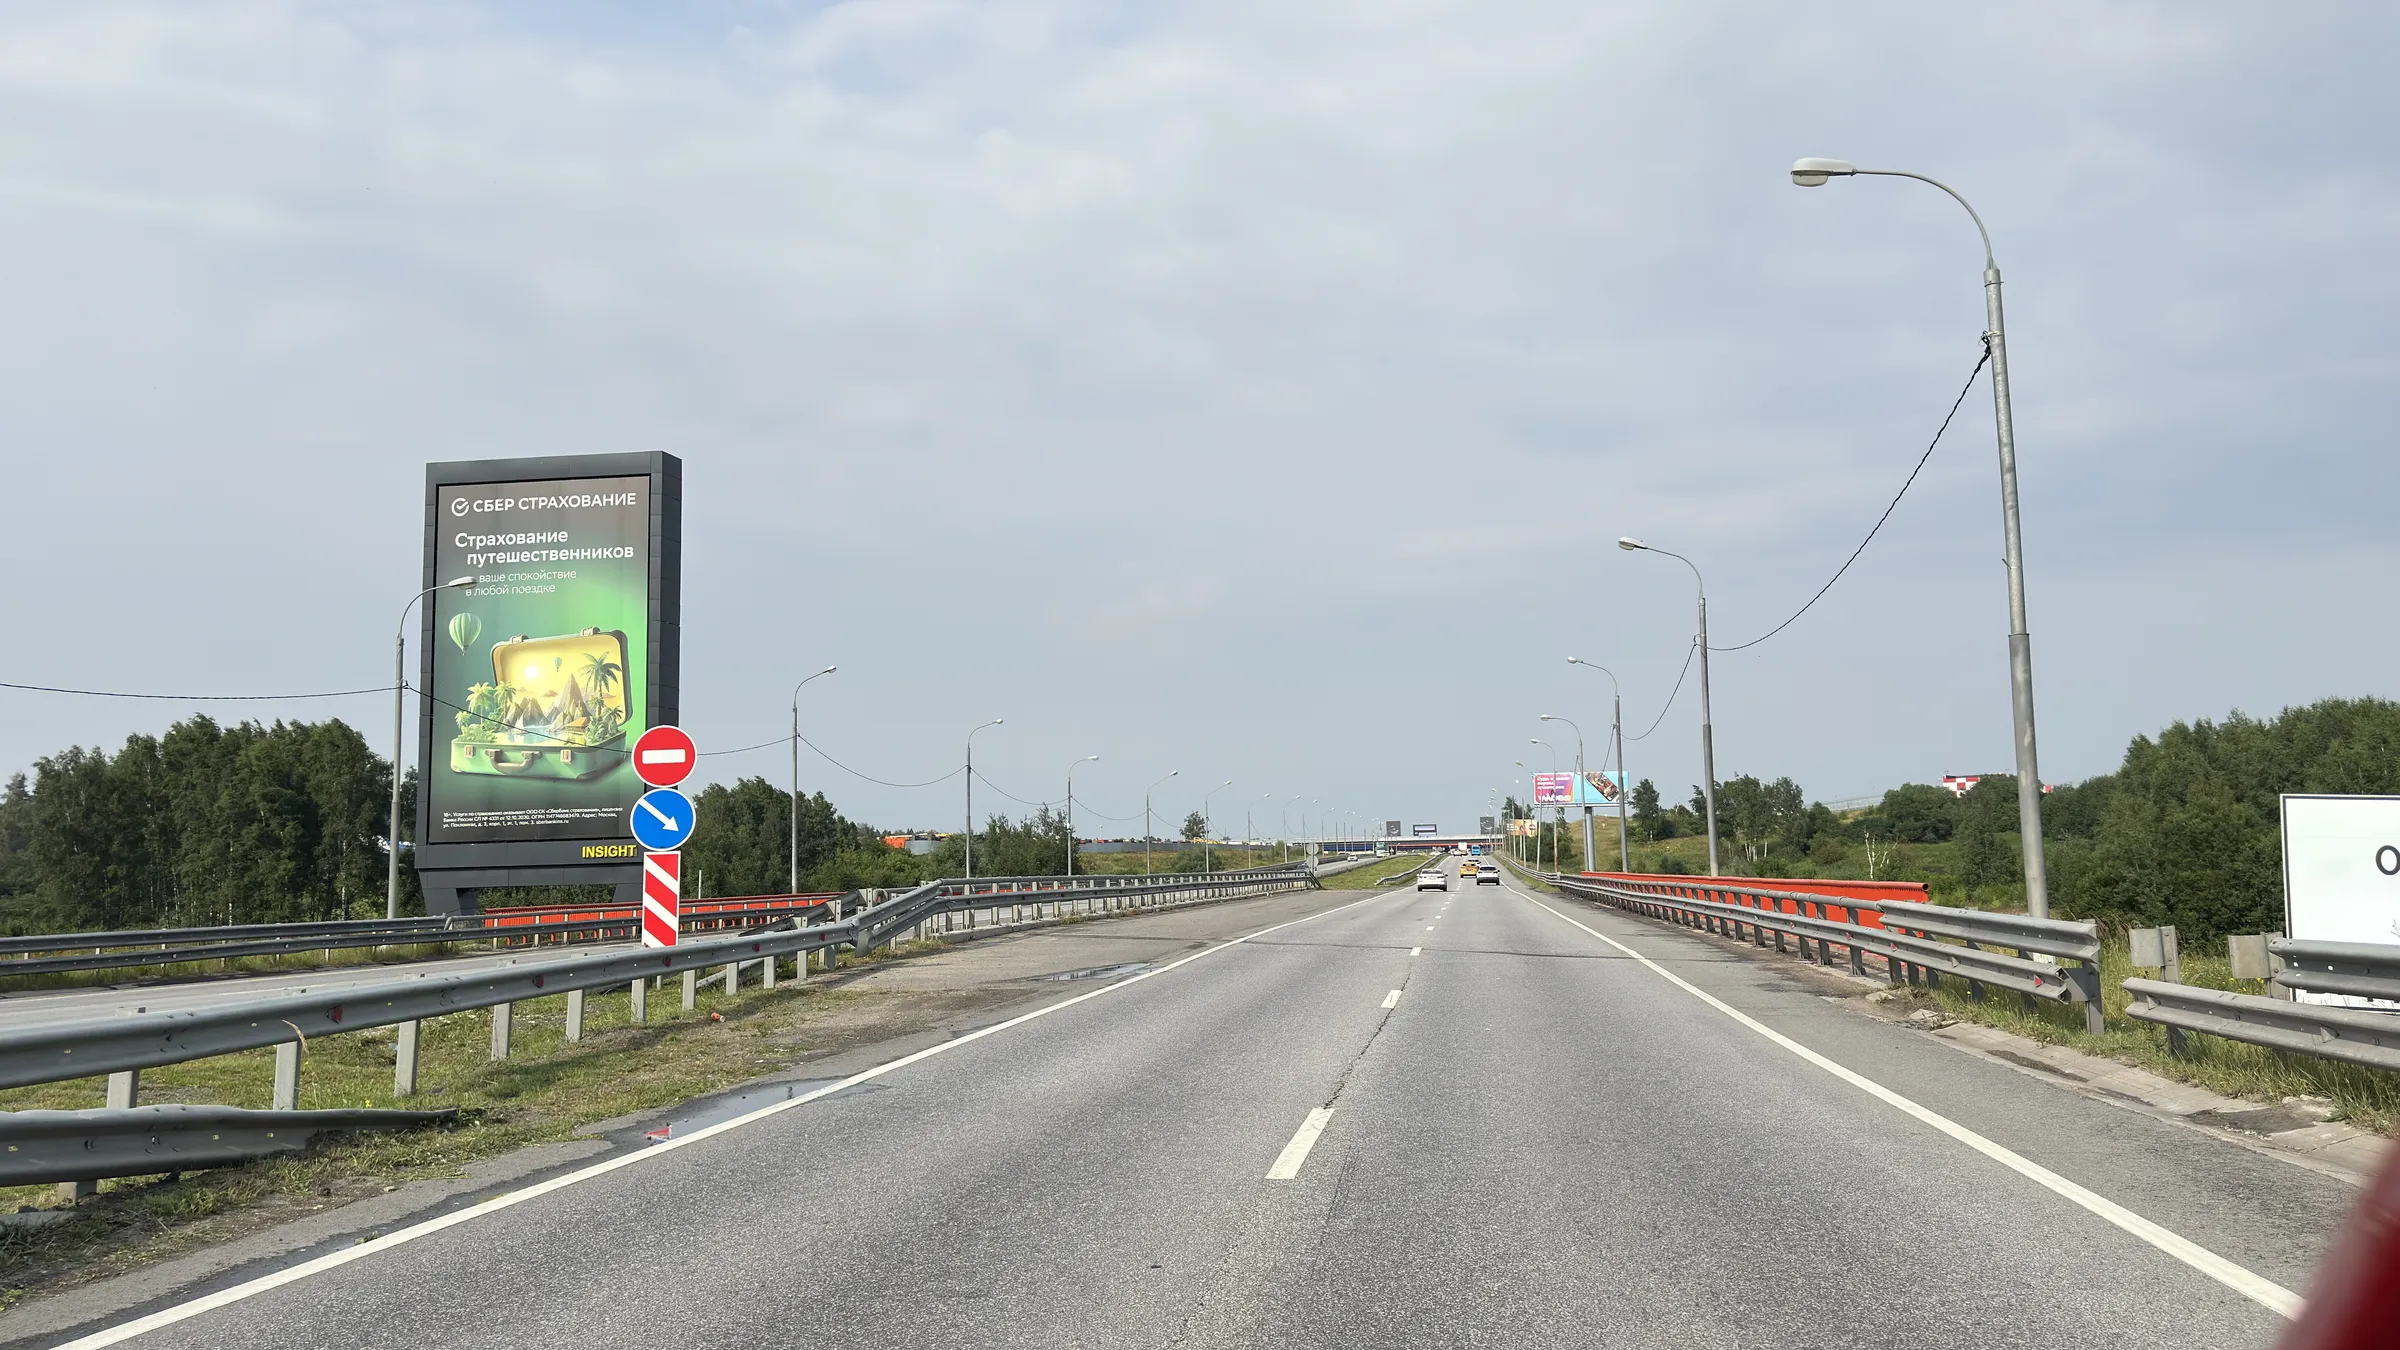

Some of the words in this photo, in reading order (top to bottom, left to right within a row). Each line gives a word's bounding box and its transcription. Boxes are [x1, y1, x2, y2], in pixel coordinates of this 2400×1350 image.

[473, 498, 514, 512] СБЕР
[518, 493, 636, 510] СТРАХОВАНИЕ
[455, 530, 568, 549] Страхование
[467, 546, 634, 568] путешественников
[479, 573, 505, 583] ваше
[508, 570, 577, 582] спокойствие
[466, 587, 471, 596] в
[474, 585, 509, 596] любой
[512, 583, 556, 596] поездке
[582, 845, 636, 858] INSIGHT
